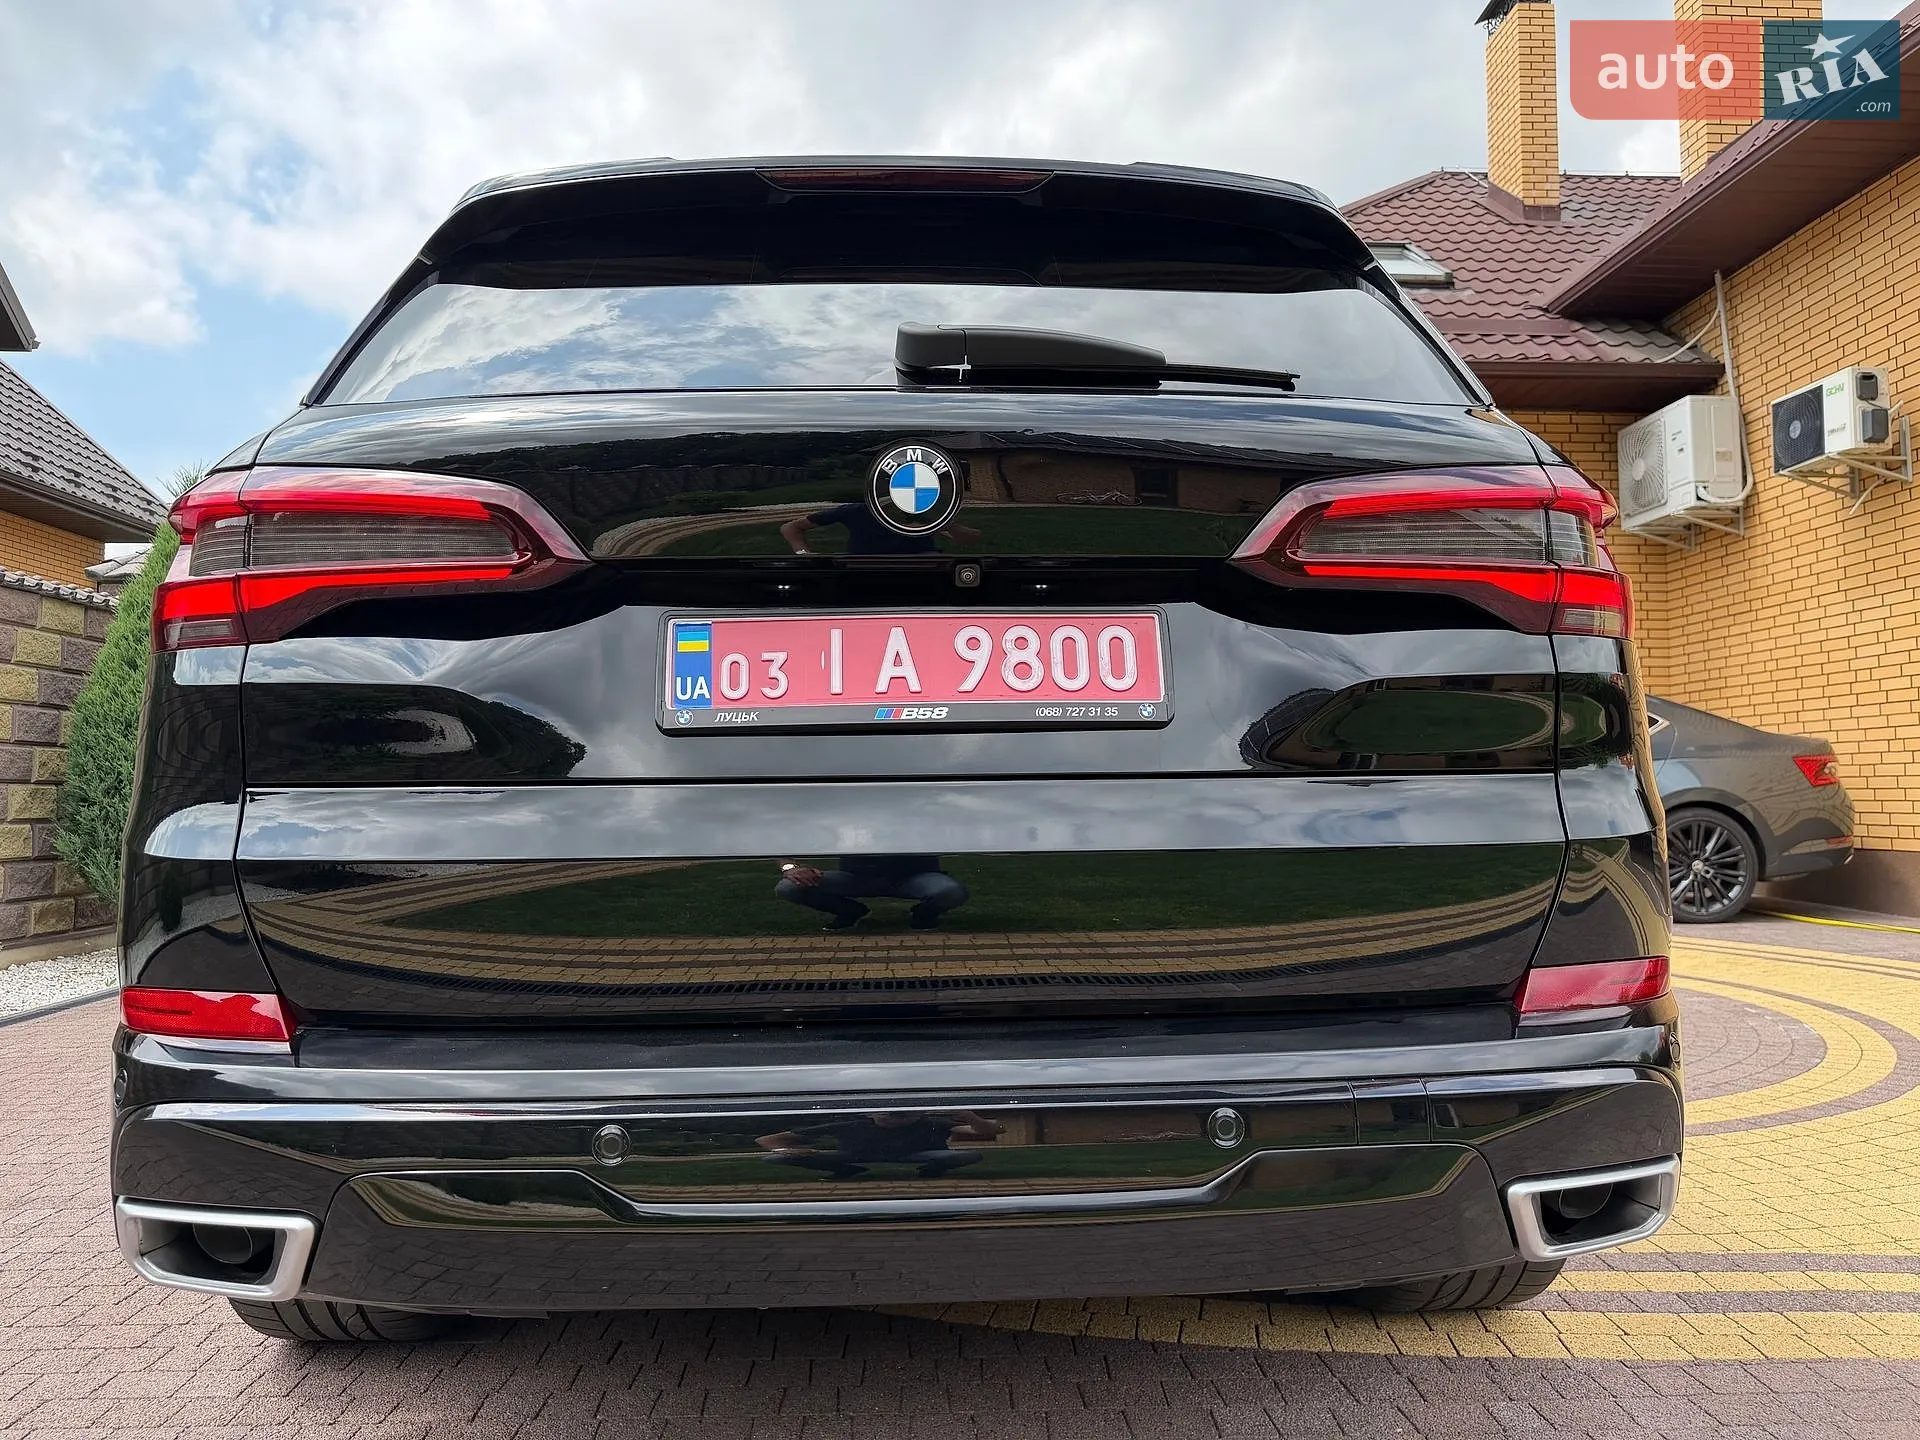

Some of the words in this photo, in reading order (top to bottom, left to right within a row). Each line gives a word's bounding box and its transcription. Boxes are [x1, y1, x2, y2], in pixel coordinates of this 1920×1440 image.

[881, 448, 949, 475] BMW
[720, 652, 789, 701] 03
[954, 624, 1138, 693] 9800
[676, 676, 710, 701] UA
[714, 711, 759, 723] ЛУЦЬК
[901, 706, 949, 720] B58
[1035, 706, 1062, 717] (068)
[1066, 706, 1085, 717] 727
[1088, 706, 1100, 717] 31
[1104, 706, 1118, 716] 35
